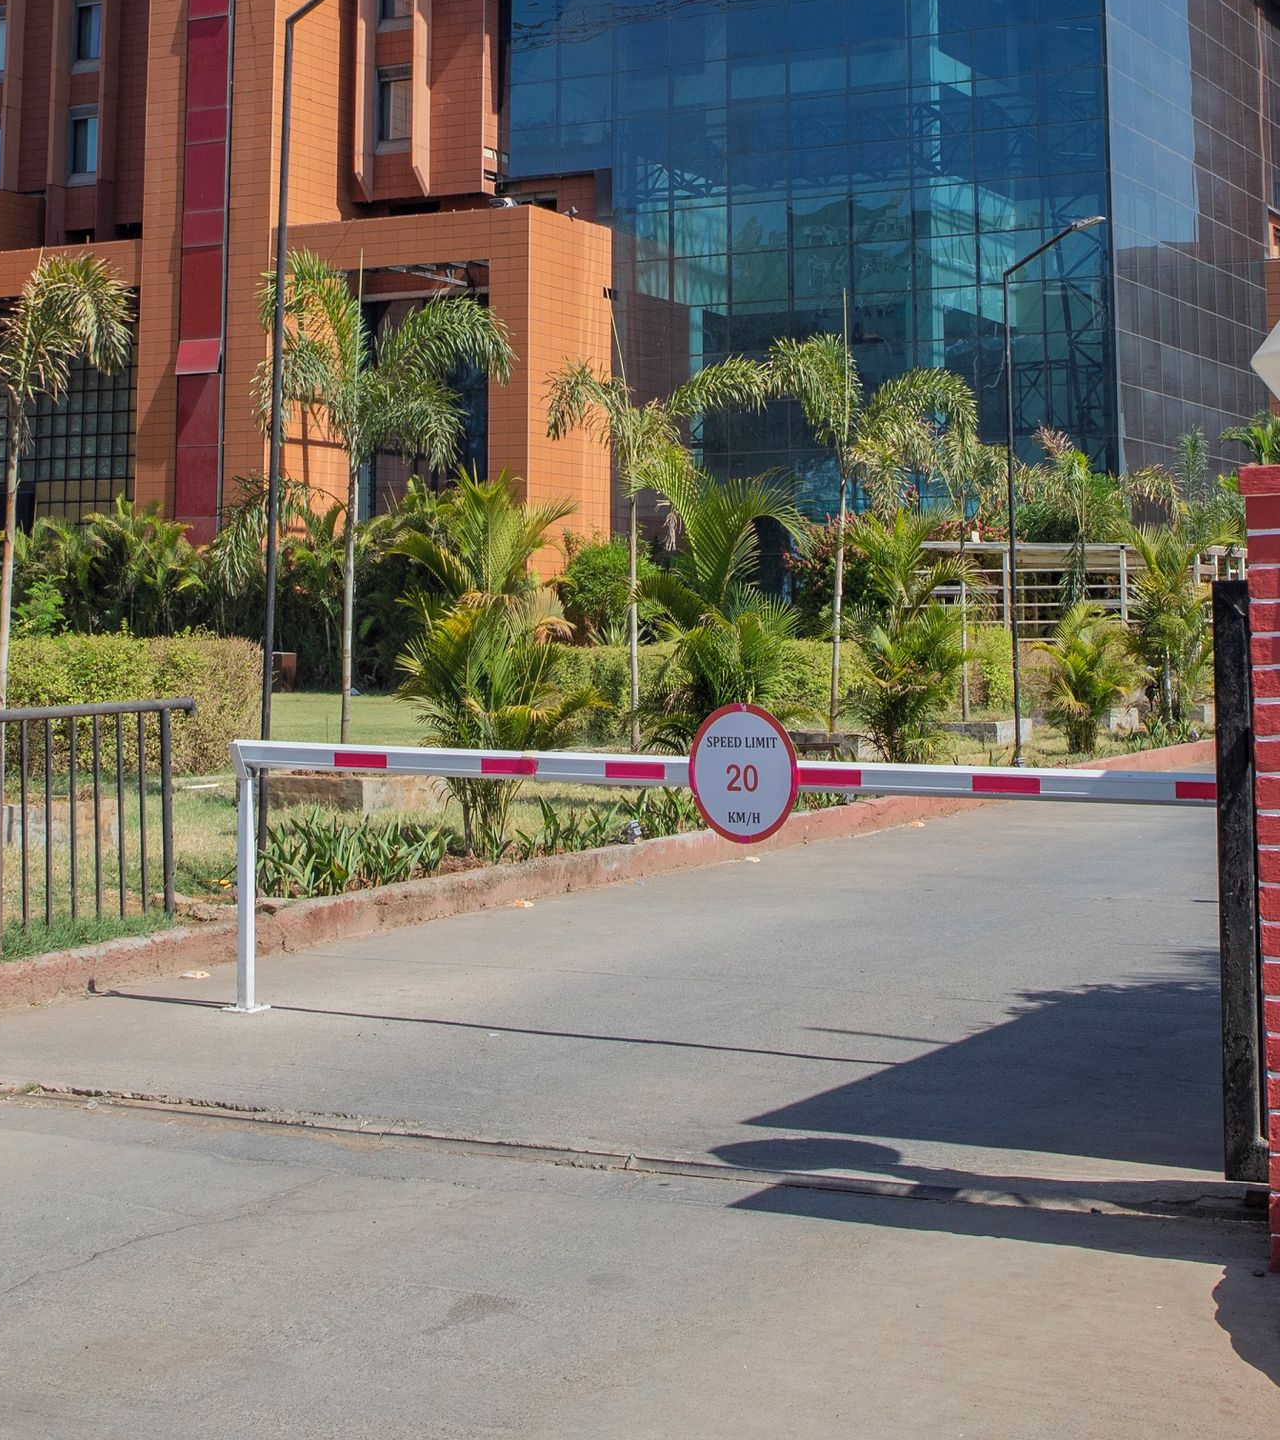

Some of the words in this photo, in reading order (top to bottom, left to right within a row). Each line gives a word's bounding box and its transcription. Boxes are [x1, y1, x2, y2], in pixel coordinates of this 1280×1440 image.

[706, 736, 742, 748] SPEED
[745, 736, 778, 749] LIMIT
[725, 763, 759, 792] 20
[727, 811, 761, 827] KM/H
